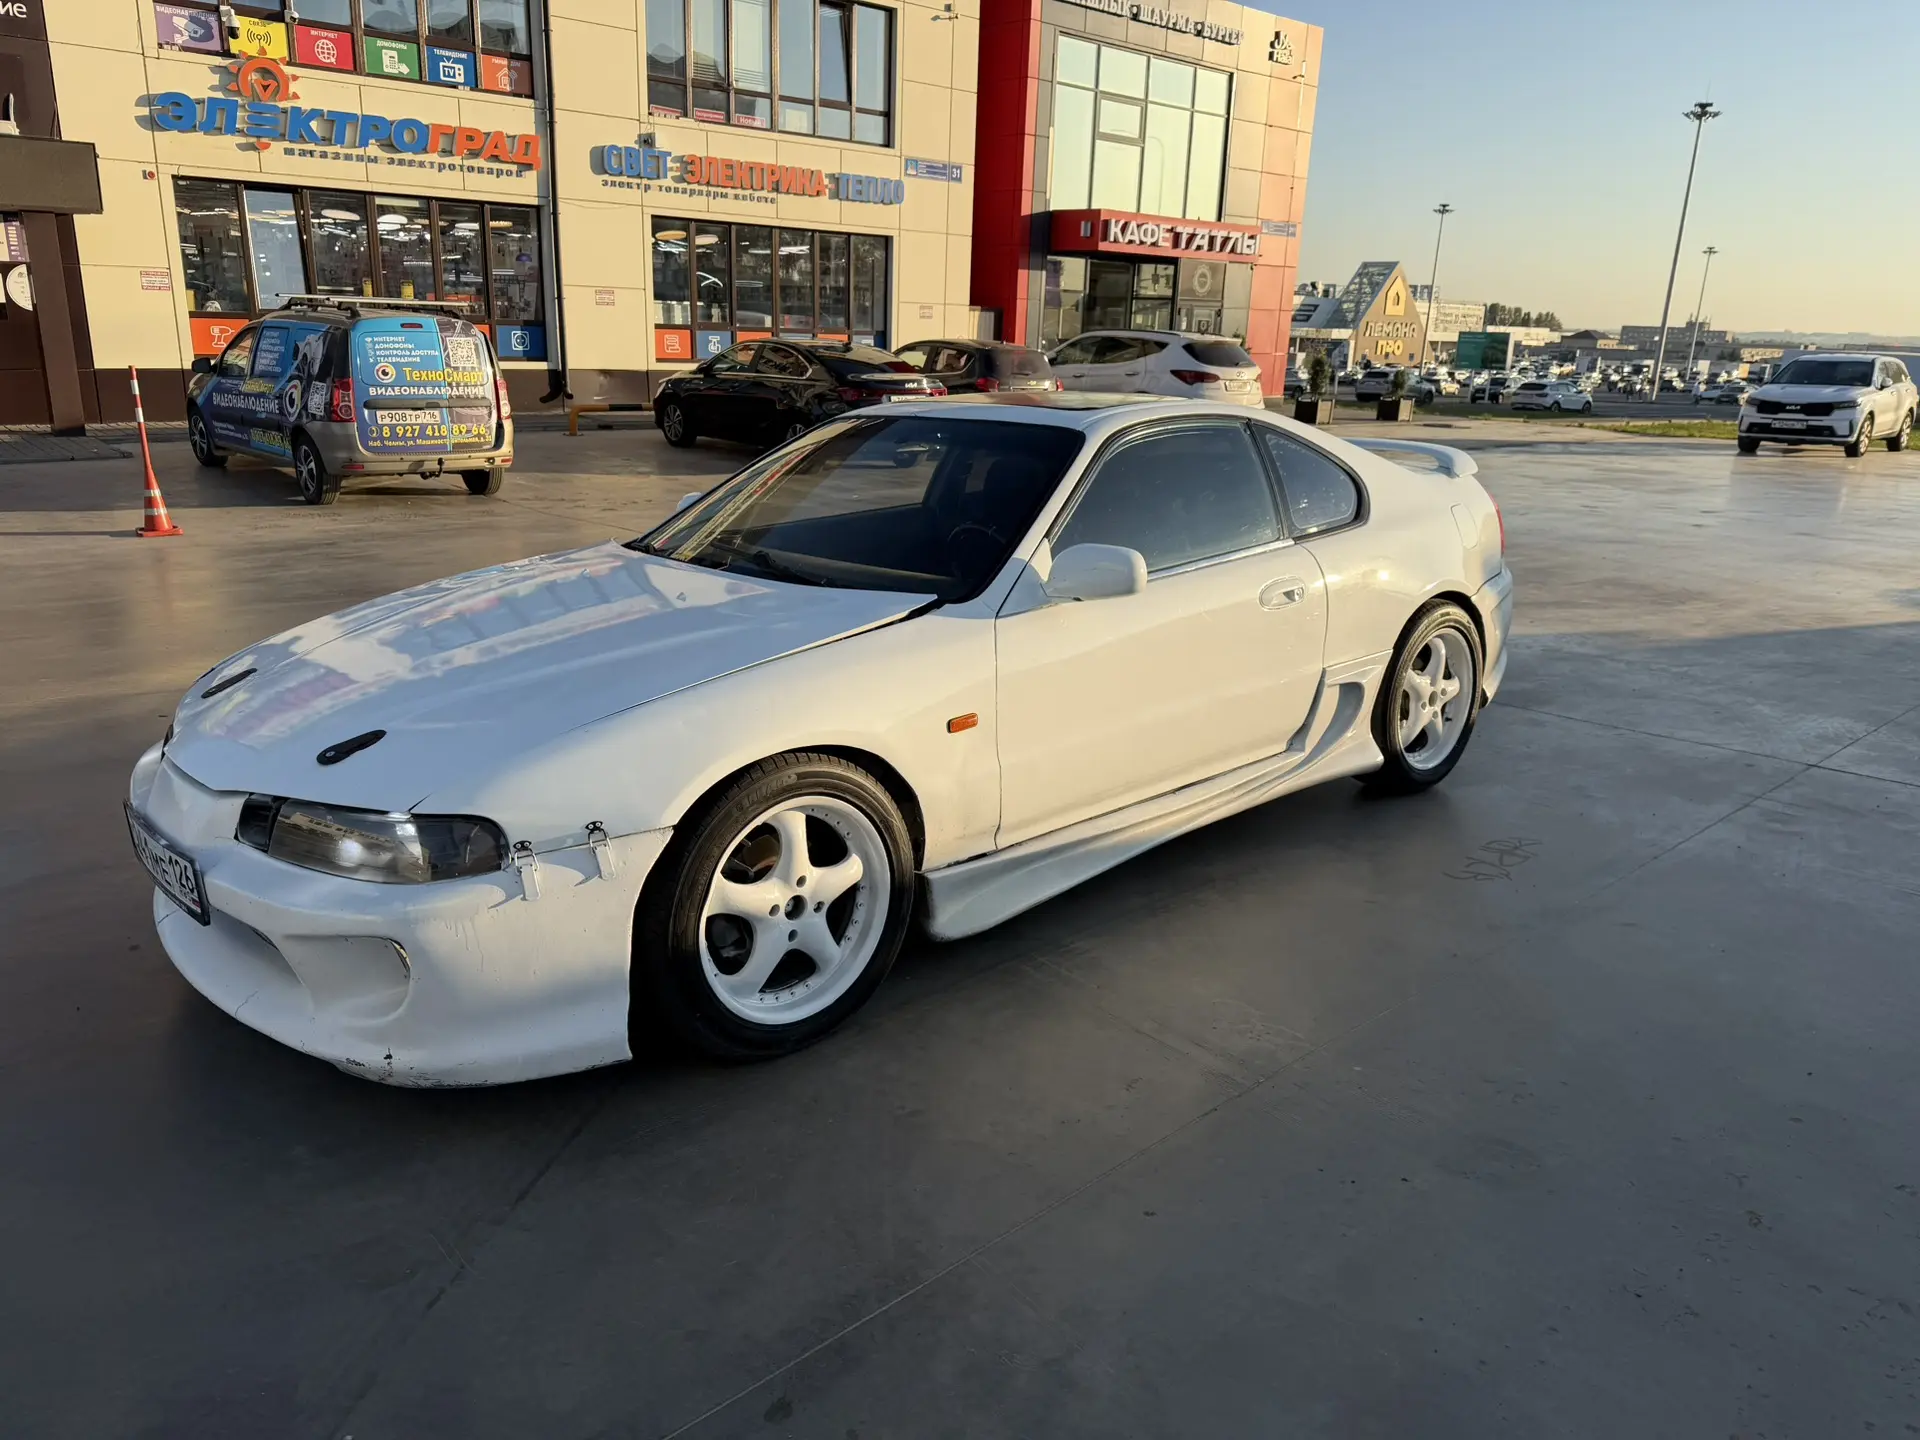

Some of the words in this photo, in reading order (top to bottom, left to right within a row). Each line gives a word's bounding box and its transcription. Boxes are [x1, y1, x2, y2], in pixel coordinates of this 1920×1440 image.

[155, 4, 218, 21] ВИДЕОНАБЛЮДЕНИЕ
[1139, 3, 1198, 35] ШАУРМА
[1202, 21, 1244, 45] БУРГЕР
[310, 29, 338, 40] ИНТЕРНЕТ
[376, 38, 408, 50] ДОМОФОНЫ
[433, 48, 468, 60] ТЕЛЕВИДЕНИЕ
[154, 91, 542, 171] ЭЛЕКТРОГРАД
[283, 147, 378, 164] магазины
[386, 156, 526, 179] электротоваров
[604, 144, 672, 179] СВЕТ
[683, 154, 827, 197] ЭЛЕКТРИКА
[836, 172, 905, 205] ТЕПЛО
[951, 167, 961, 179] 31
[601, 179, 652, 193] электр
[658, 184, 729, 200] товарлары
[1109, 218, 1171, 247] КАФЕ
[1364, 321, 1417, 338] ЛЕМАНА
[1376, 339, 1404, 356] ПРО
[402, 367, 484, 384] ТехноСмарт
[368, 386, 485, 397] ВИДЕОНАБЛЮДЕНИЕ
[212, 392, 280, 414] ВИДЕОНАБЛЮДЕНИЕ
[382, 426, 391, 437] 8
[395, 425, 420, 437] 927
[425, 424, 448, 437] 418
[452, 424, 467, 436] 89
[471, 424, 486, 435] 66
